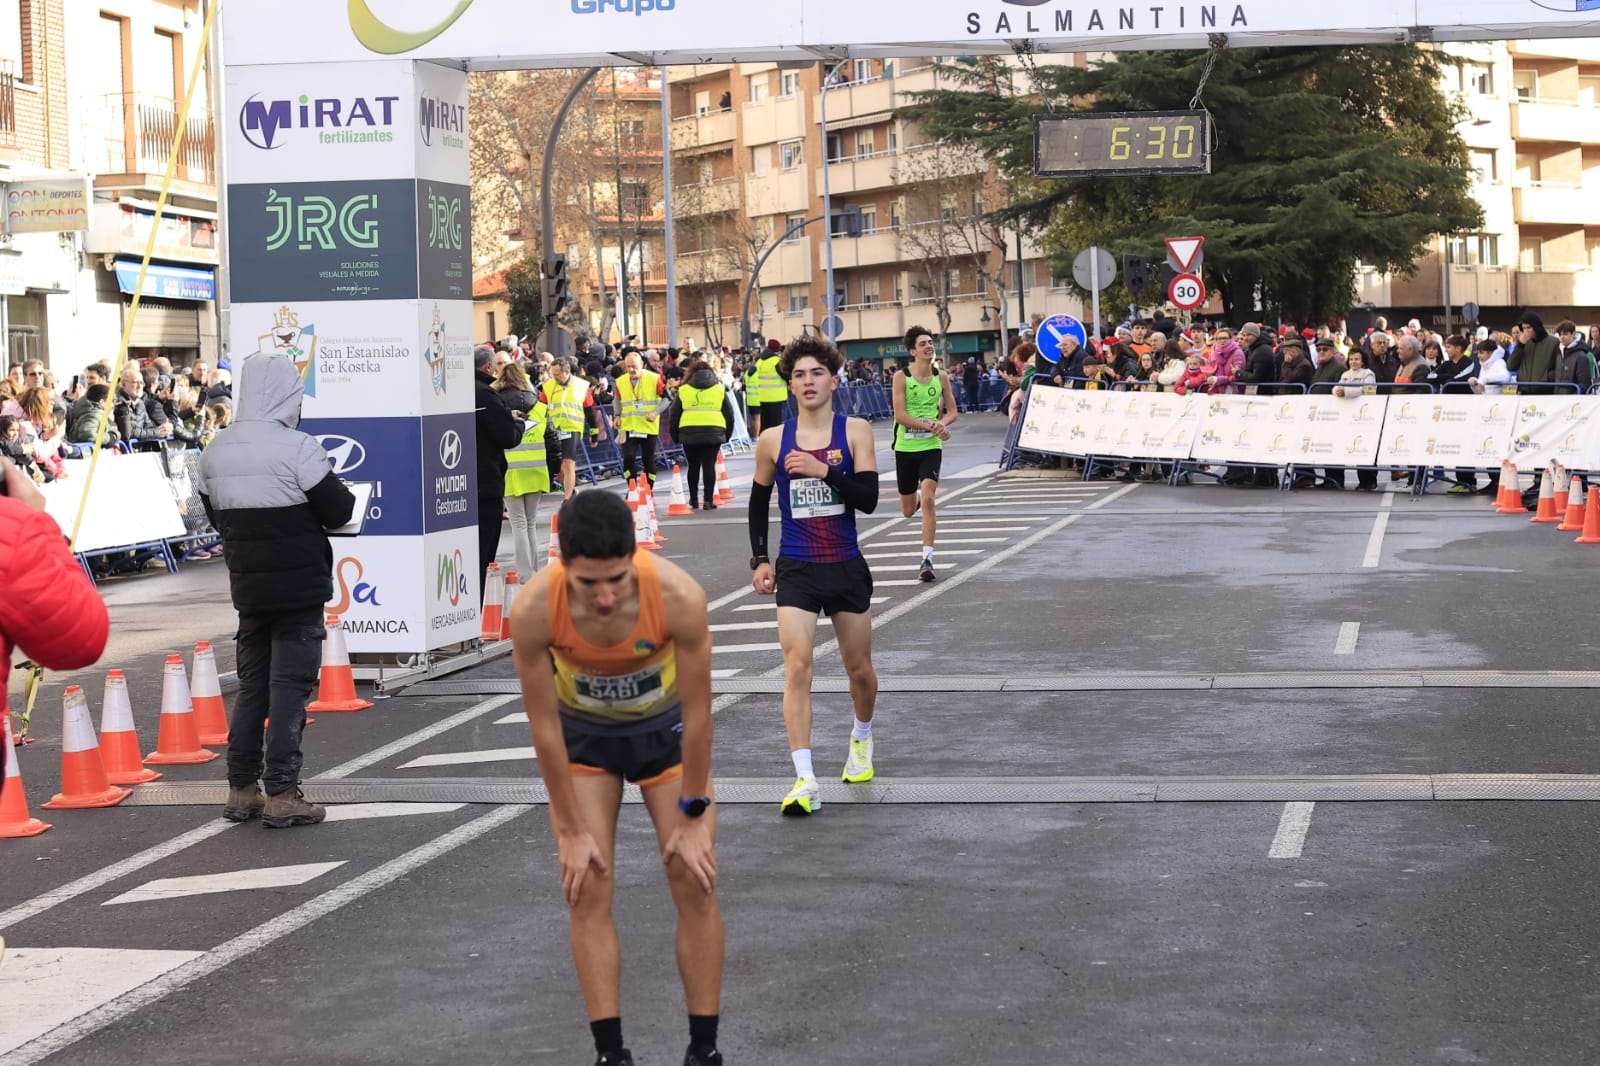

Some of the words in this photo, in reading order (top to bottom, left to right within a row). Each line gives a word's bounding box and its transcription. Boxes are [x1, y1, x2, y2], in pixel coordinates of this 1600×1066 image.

[571, 0, 676, 16] Grupo
[966, 5, 1248, 35] SALMANTINA
[319, 130, 393, 144] fertilizantes
[1110, 125, 1195, 160] 6:30
[50, 190, 82, 199] DEPORTES
[340, 261, 380, 269] SOLUCIONES
[319, 270, 349, 278] VISUALES
[1176, 286, 1197, 298] 30
[320, 346, 342, 359] San
[346, 345, 410, 359] Estanislao
[320, 361, 335, 374] de
[338, 360, 381, 374] Kostka
[435, 474, 467, 495] HYUNDAI
[797, 487, 832, 505] 5603
[435, 496, 468, 516] Gestorauto
